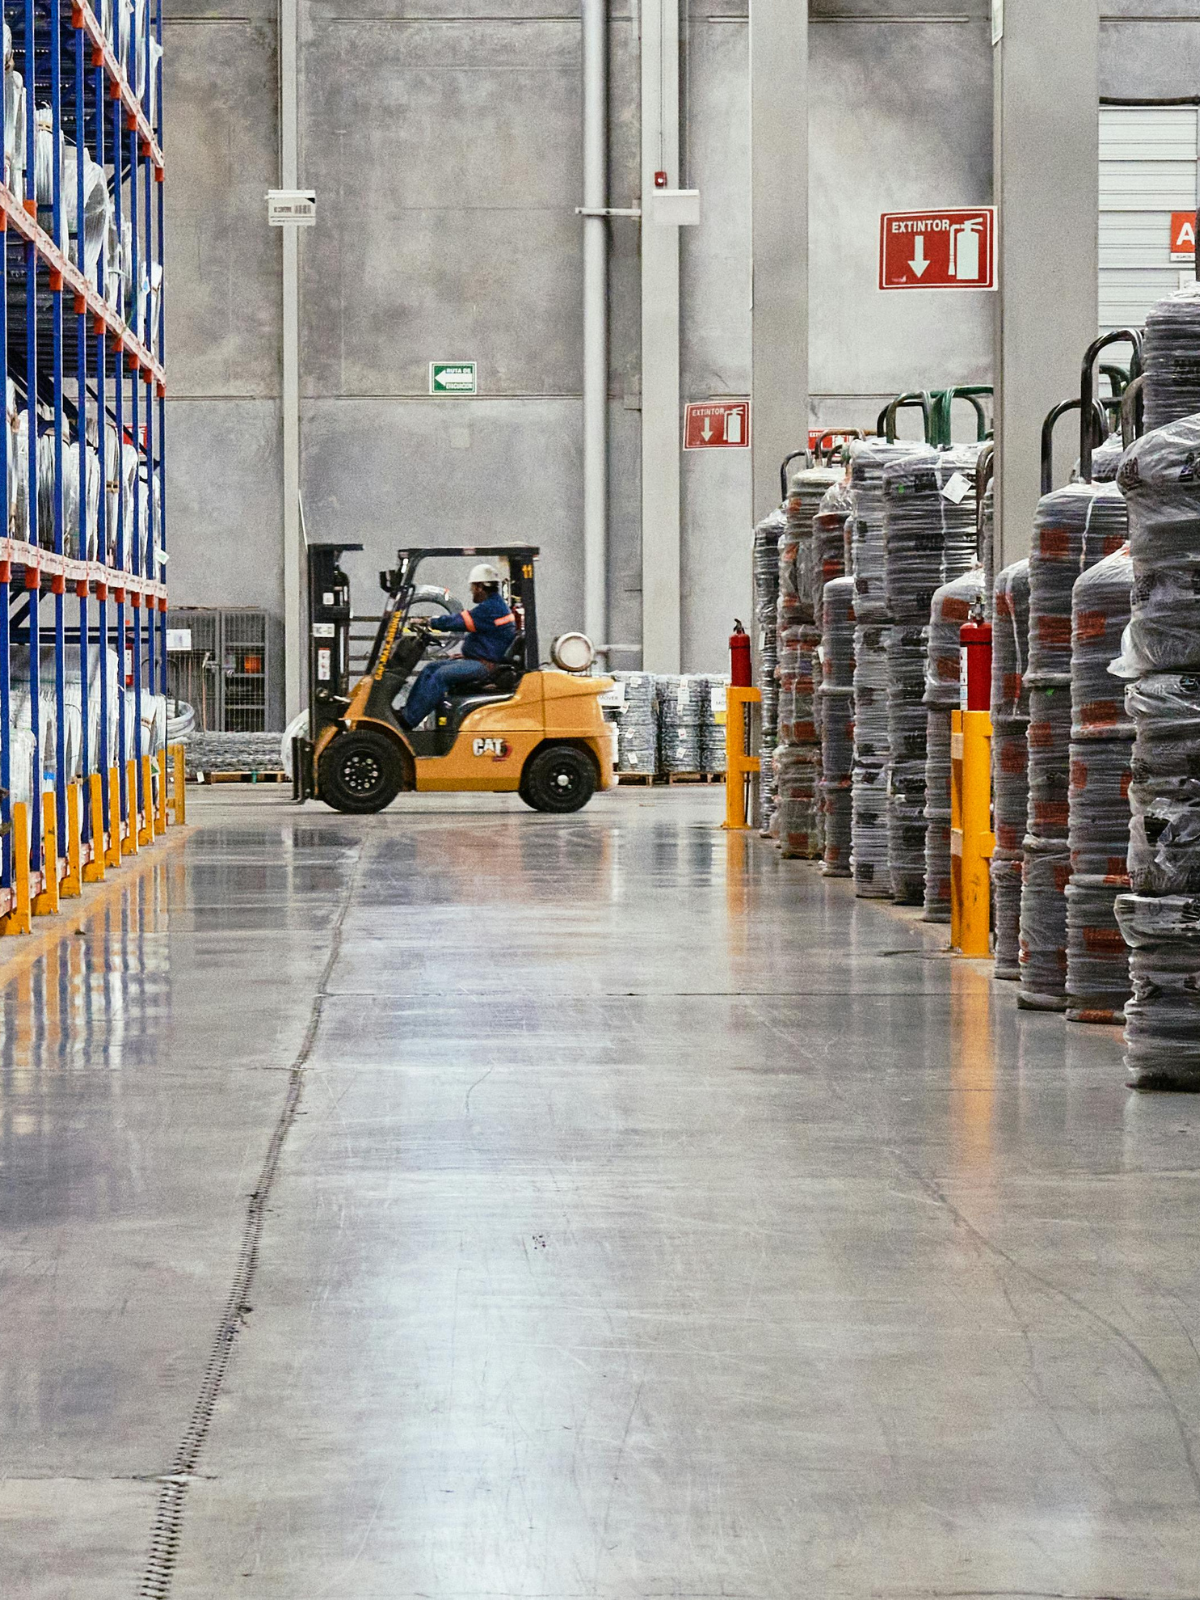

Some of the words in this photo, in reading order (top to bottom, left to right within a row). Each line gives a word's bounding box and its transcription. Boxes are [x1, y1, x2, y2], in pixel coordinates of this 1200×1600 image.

[892, 219, 950, 233] EXTINTOR
[1176, 222, 1195, 245] A
[692, 407, 725, 417] EXTINTOR
[522, 564, 533, 579] 11
[472, 738, 504, 757] CAT
